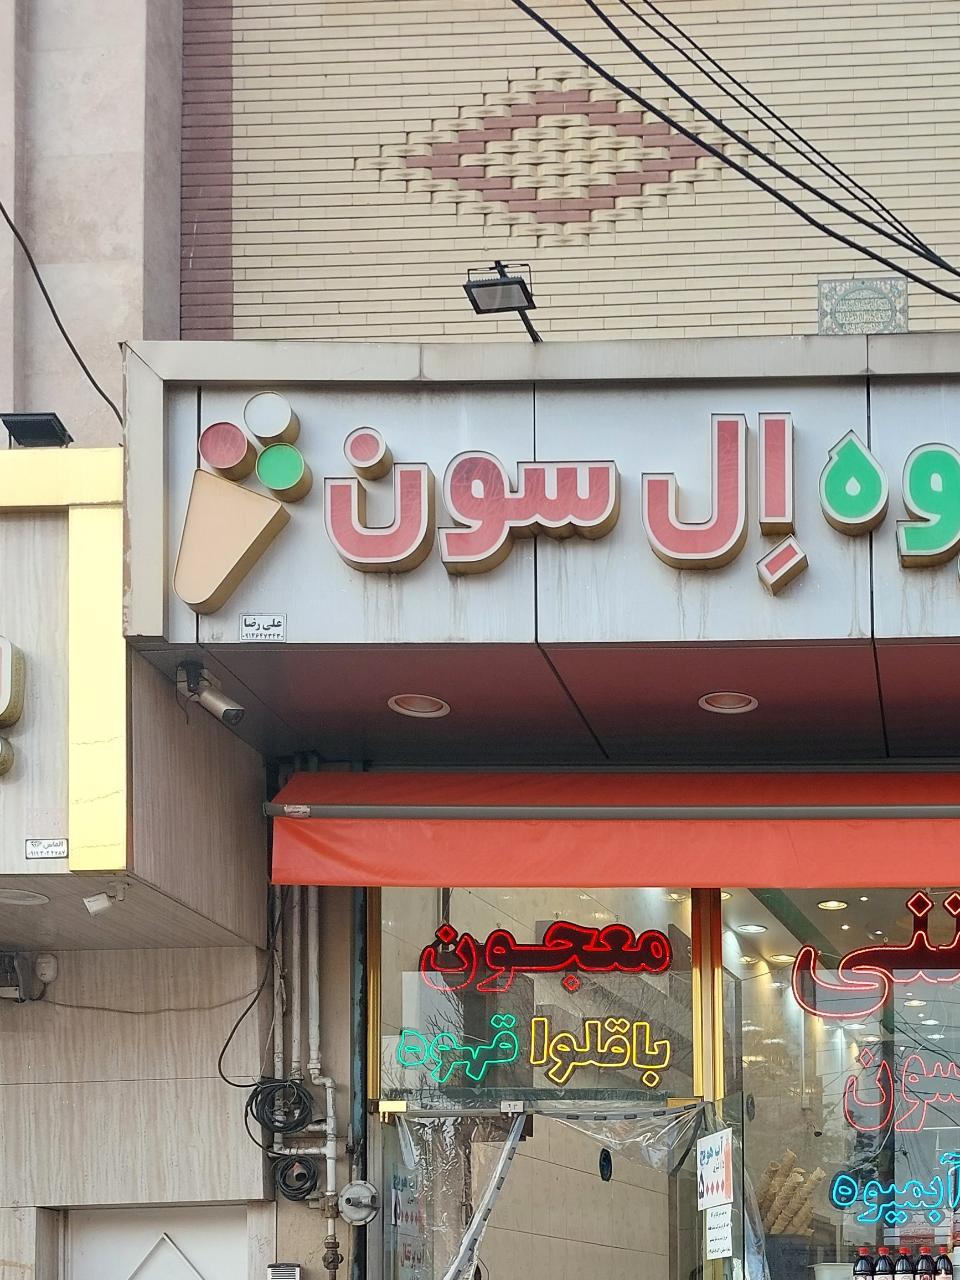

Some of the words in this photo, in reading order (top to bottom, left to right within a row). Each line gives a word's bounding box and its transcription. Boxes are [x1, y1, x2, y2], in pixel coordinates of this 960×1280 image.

[324, 425, 620, 576] سون
[244, 617, 261, 631] رضا
[262, 618, 282, 631] علی
[43, 840, 64, 849] الماس
[419, 920, 673, 993] معجون
[397, 1013, 519, 1083] قهوه
[529, 1017, 671, 1088] باقلوا
